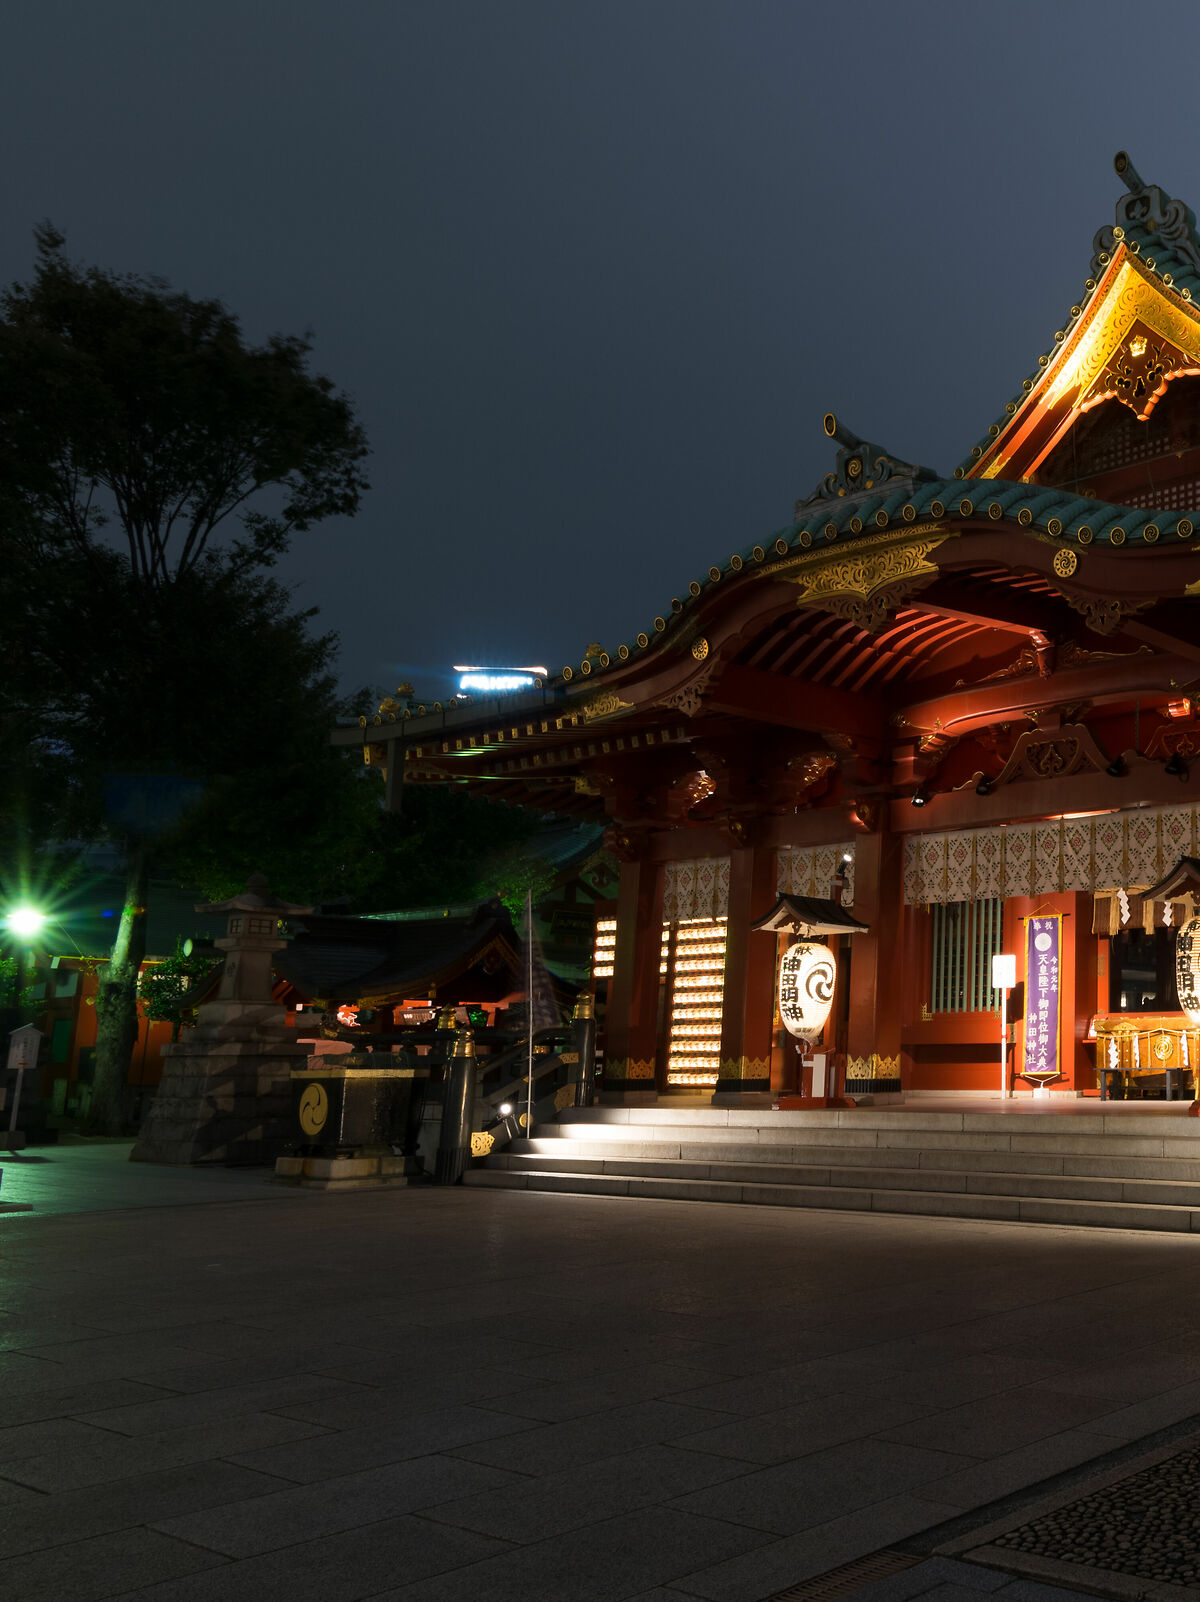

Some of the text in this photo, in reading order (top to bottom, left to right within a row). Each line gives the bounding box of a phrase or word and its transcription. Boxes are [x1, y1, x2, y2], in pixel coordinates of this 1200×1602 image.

[1033, 921, 1054, 931] 奉祝
[781, 956, 804, 1022] 神田明神
[1050, 956, 1058, 993] 令和元年
[1037, 954, 1049, 1068] 天皇陛下御即位御大典
[1027, 1012, 1037, 1064] 神田神社
